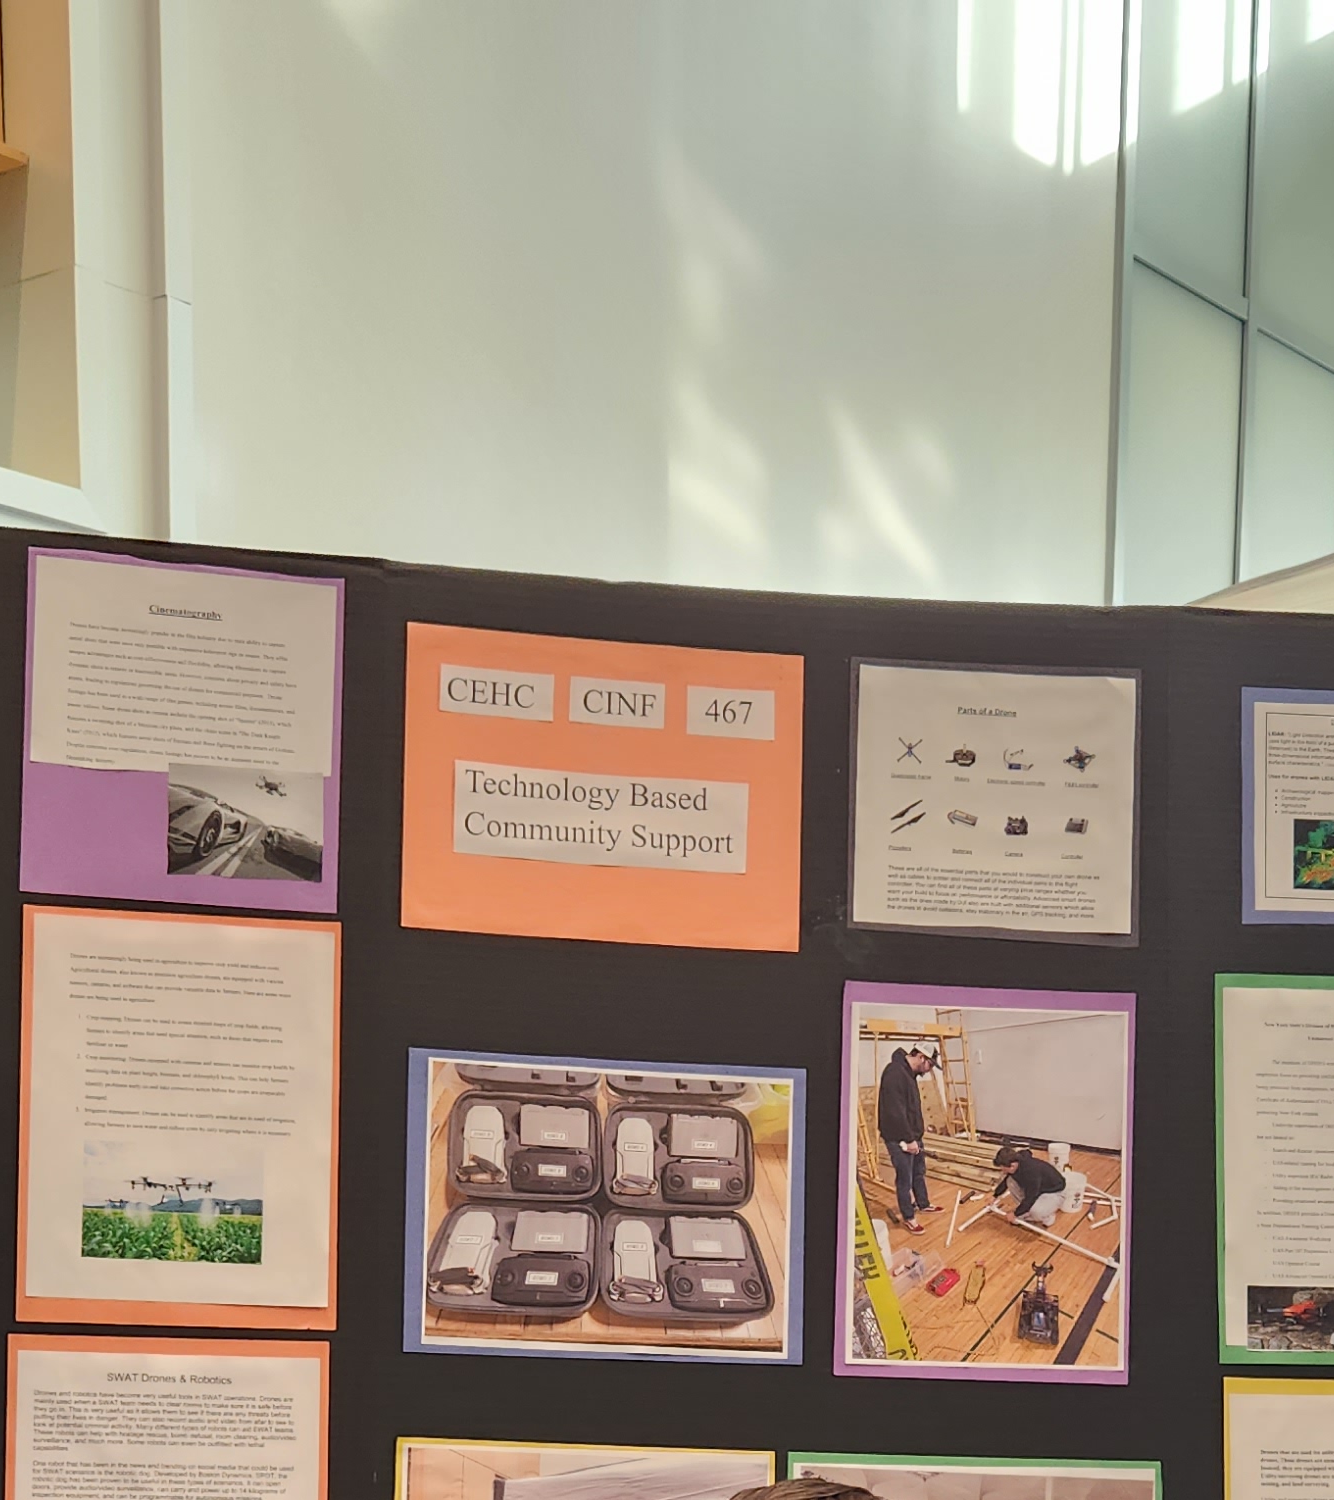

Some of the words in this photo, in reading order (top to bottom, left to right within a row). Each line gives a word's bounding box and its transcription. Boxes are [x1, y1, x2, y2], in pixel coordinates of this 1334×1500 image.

[148, 604, 222, 621] Cinematography
[447, 677, 535, 709] CEHC
[583, 689, 657, 718] CINF
[705, 699, 753, 725] 467
[465, 768, 620, 812] Technology
[630, 782, 708, 812] Based
[464, 811, 622, 852] Community
[631, 823, 734, 858] Support
[107, 1372, 139, 1383] SWAT
[141, 1373, 176, 1384] Drones
[180, 1374, 187, 1384] &
[189, 1374, 233, 1385] Robotics
